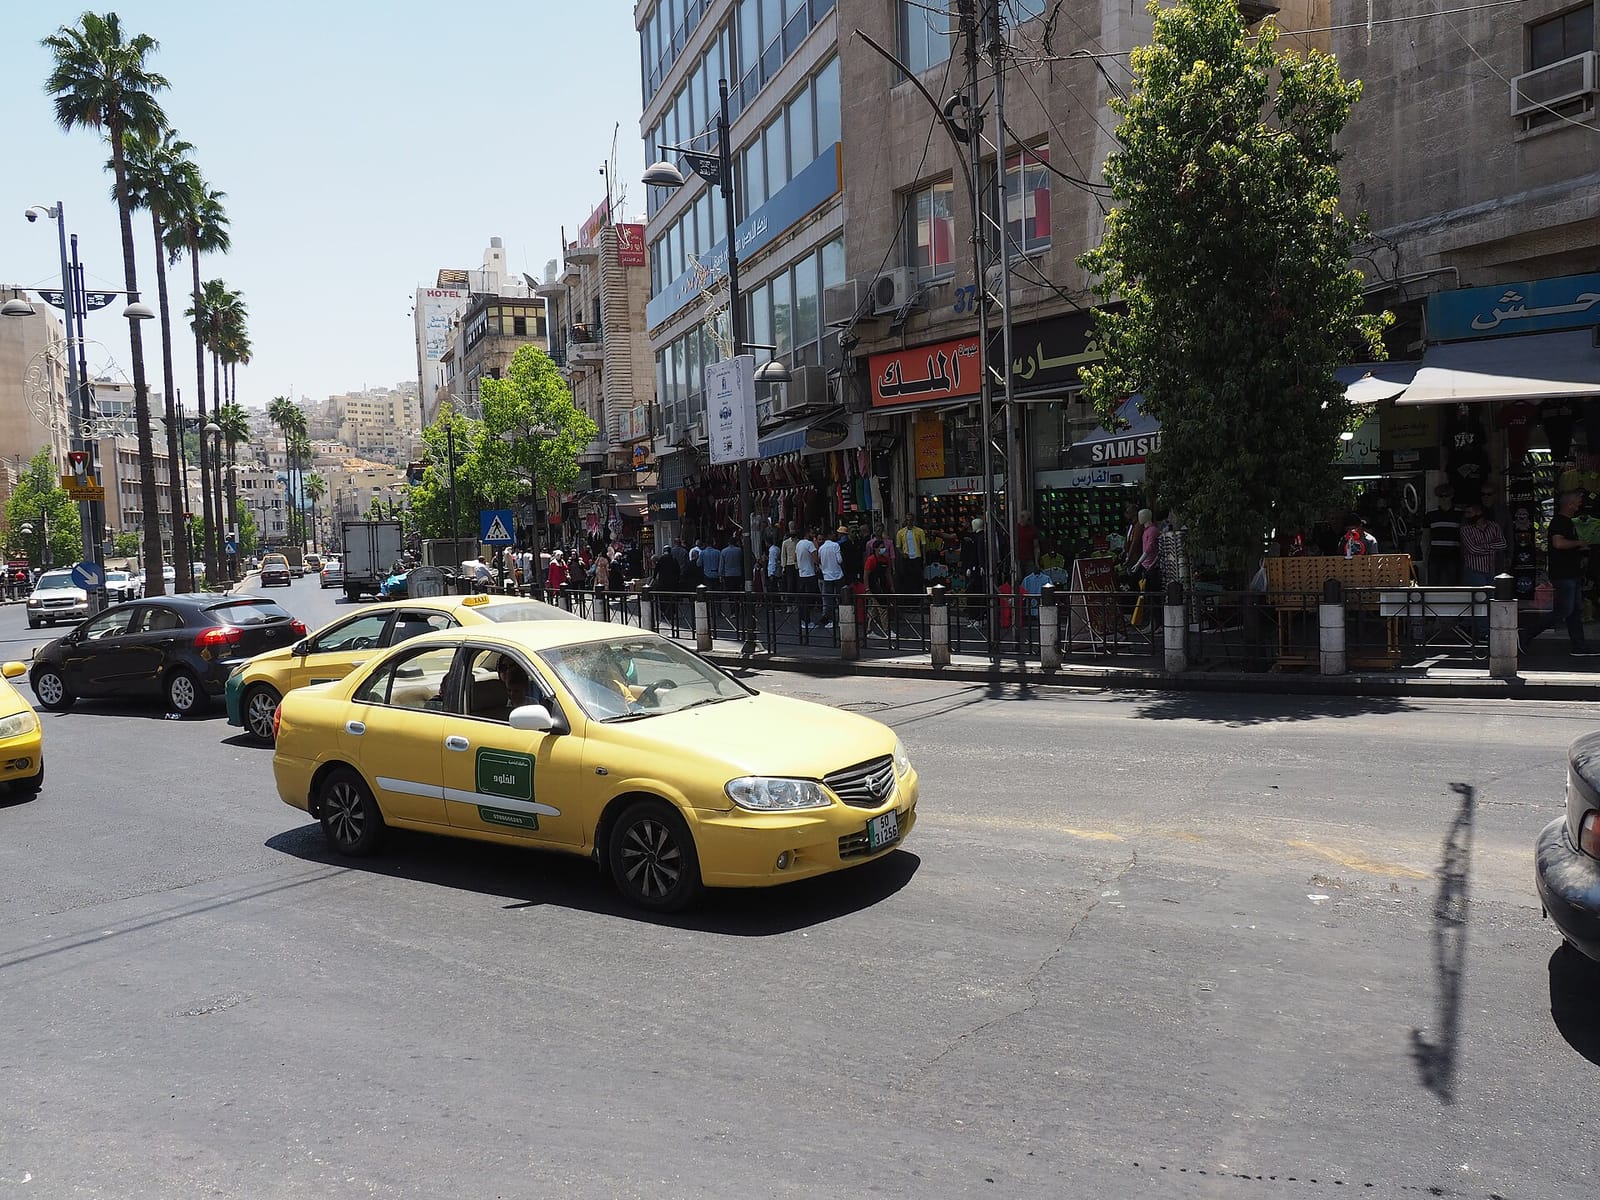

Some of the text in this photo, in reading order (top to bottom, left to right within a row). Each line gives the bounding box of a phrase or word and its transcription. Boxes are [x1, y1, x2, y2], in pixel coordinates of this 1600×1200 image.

[426, 290, 461, 298] HOTEL
[876, 348, 962, 400] الملك
[1072, 469, 1110, 486] الفارس
[474, 595, 488, 604] TAXI
[492, 773, 515, 786] الخلود
[880, 814, 890, 829] 50
[874, 824, 898, 846] 31256
